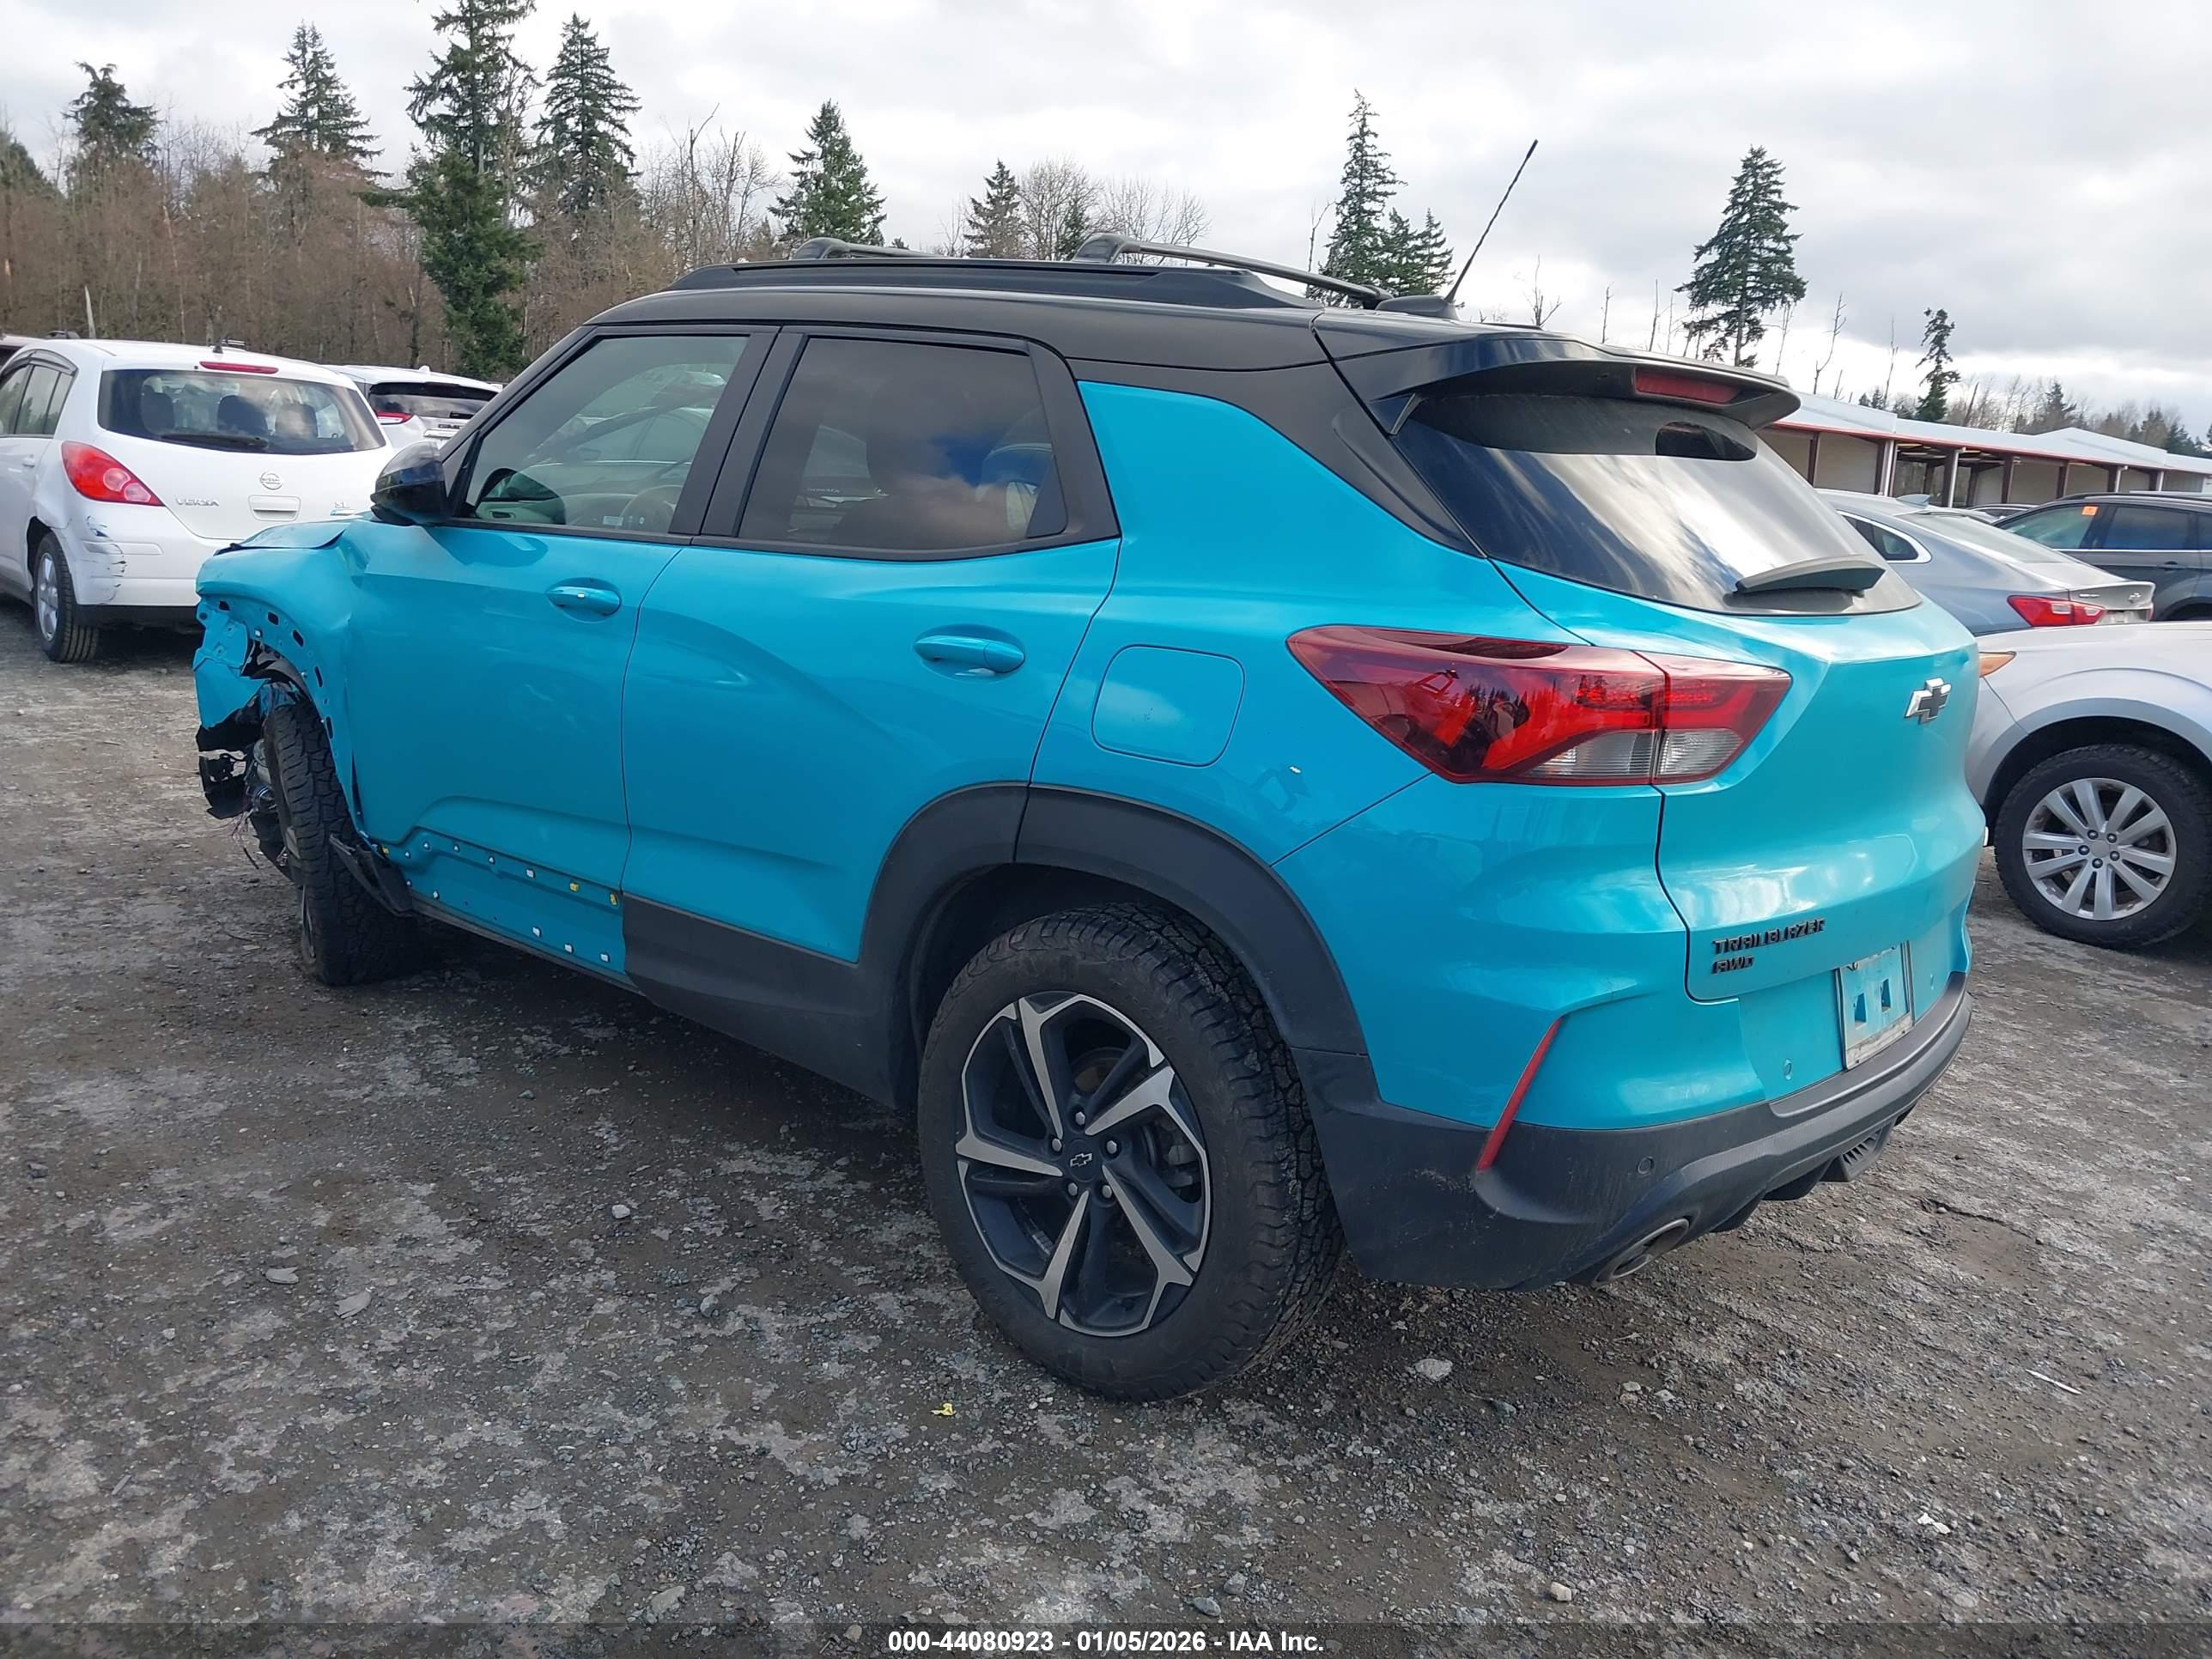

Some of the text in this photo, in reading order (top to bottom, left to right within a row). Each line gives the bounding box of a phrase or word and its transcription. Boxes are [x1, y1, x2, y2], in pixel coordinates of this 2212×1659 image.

[175, 497, 219, 507] VERSA
[1713, 918, 1825, 954] TRAILBLAZER
[1711, 956, 1754, 973] AWD
